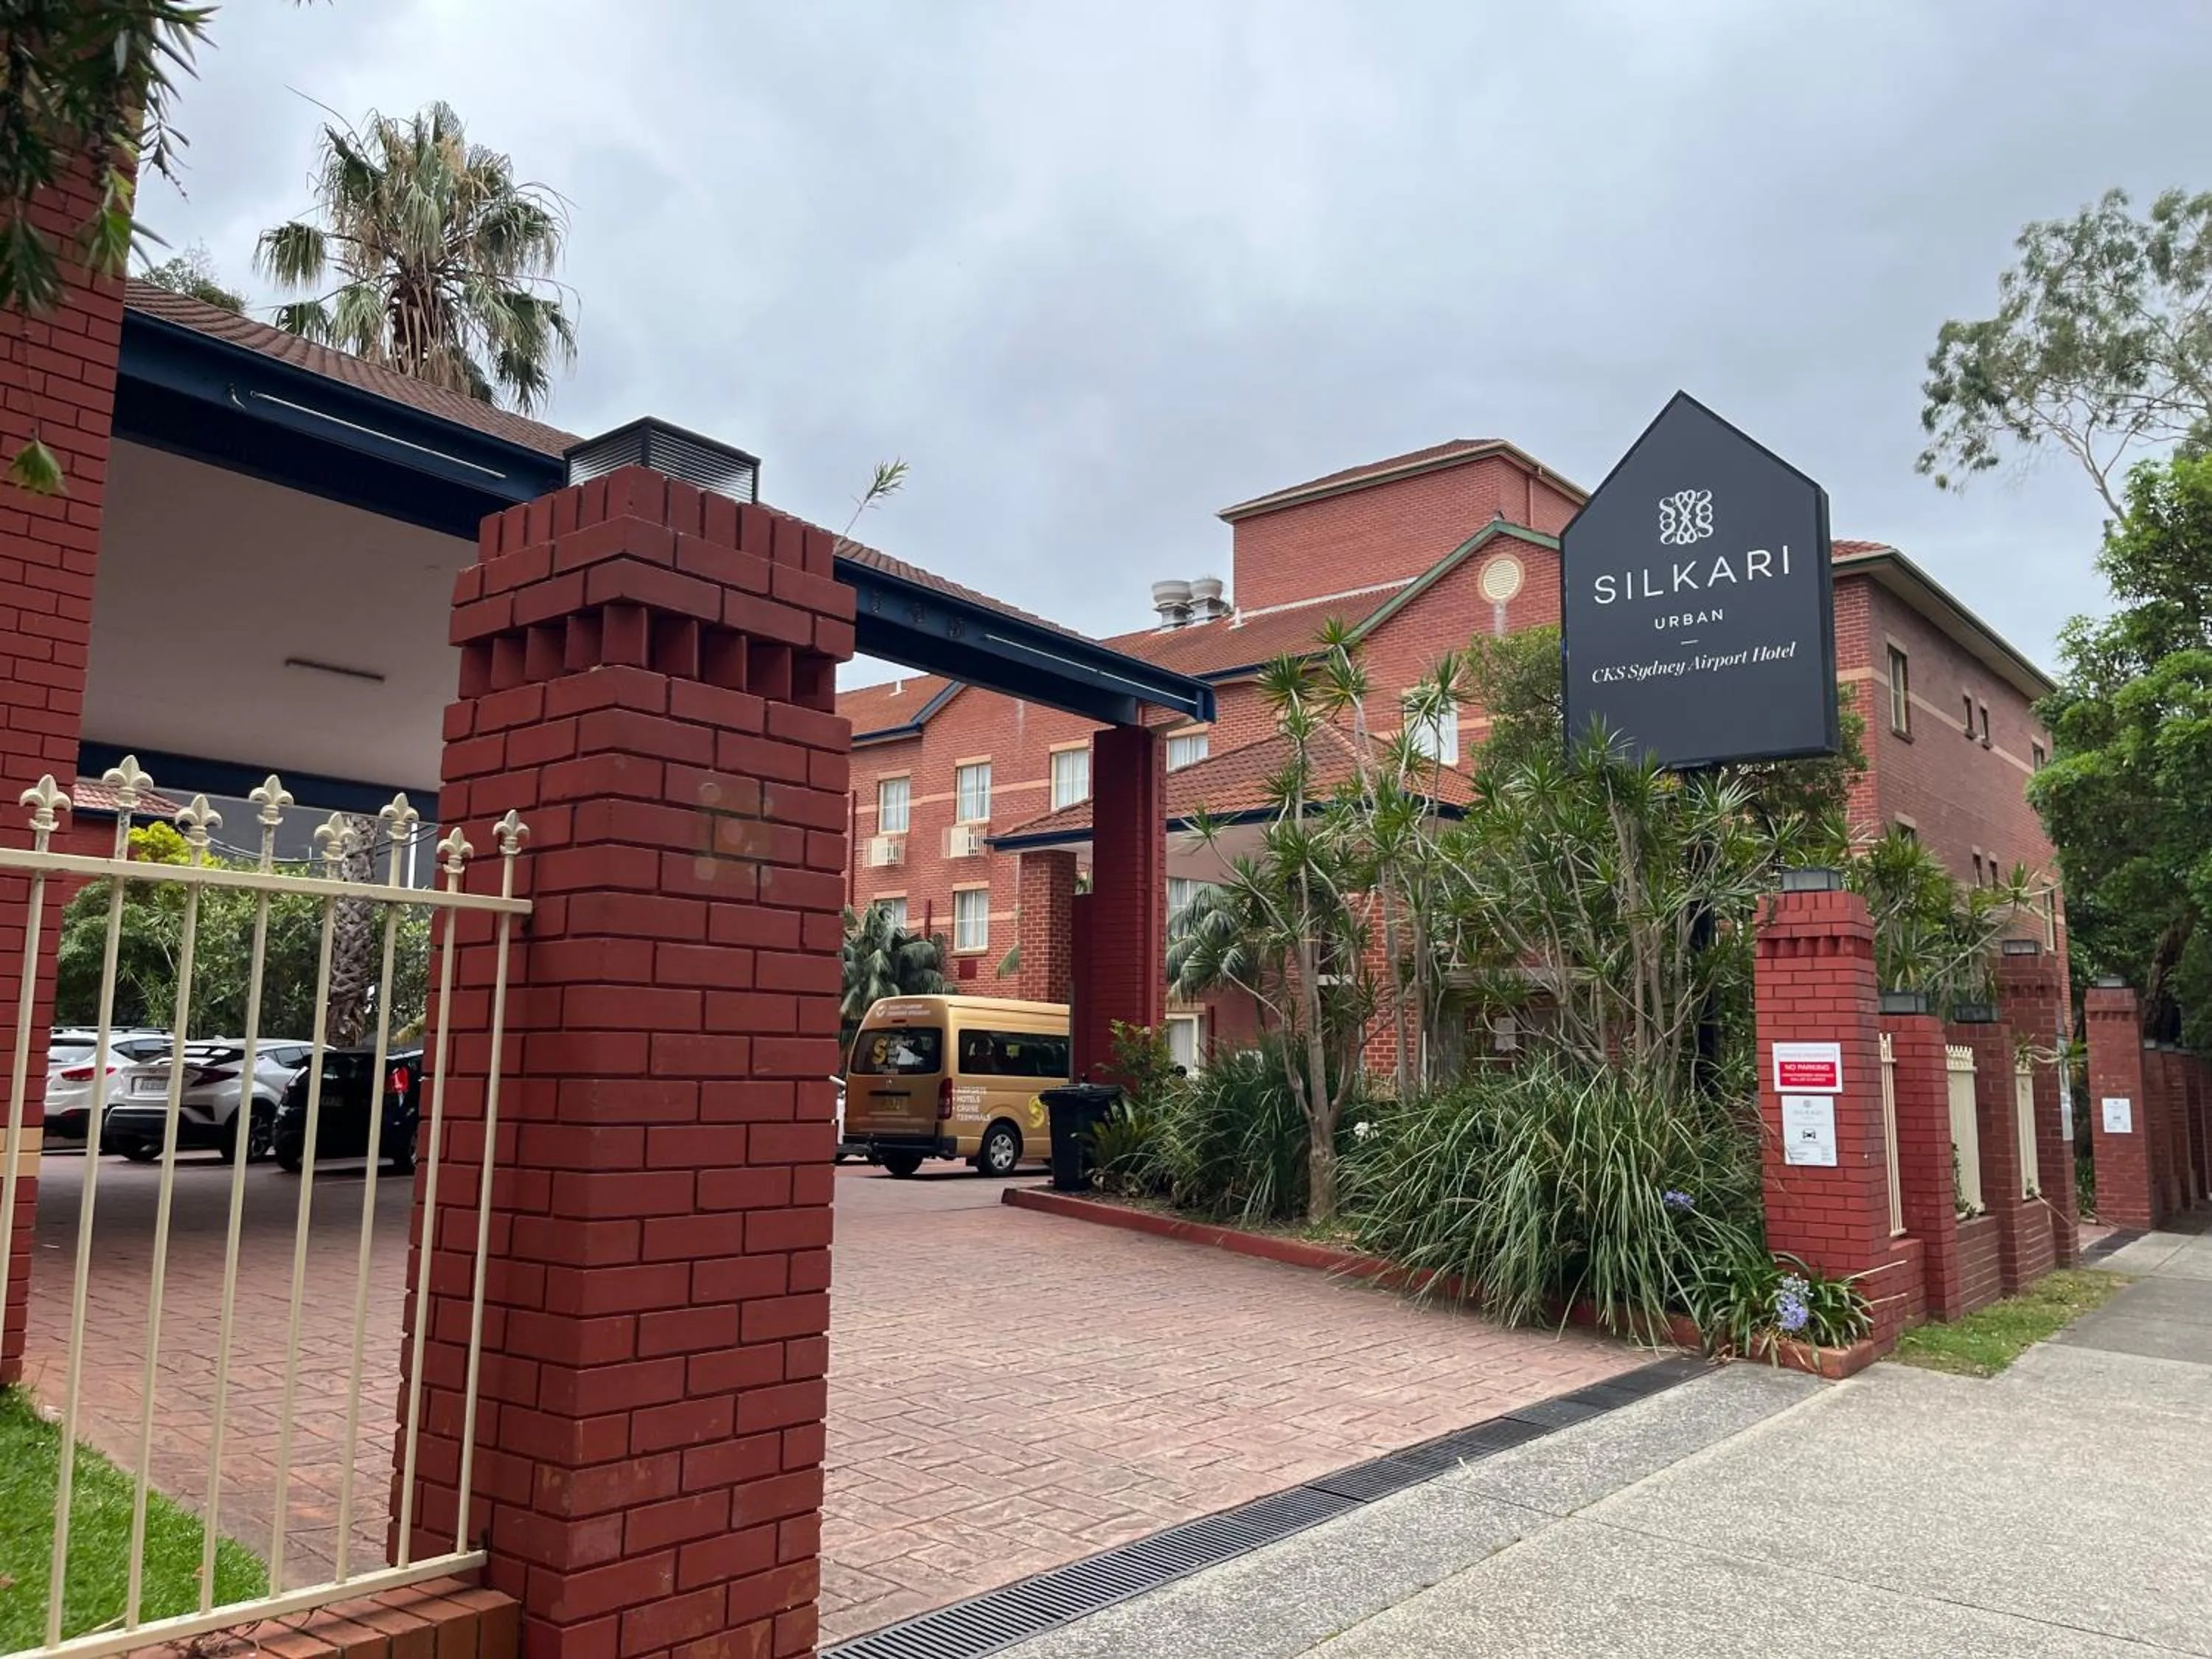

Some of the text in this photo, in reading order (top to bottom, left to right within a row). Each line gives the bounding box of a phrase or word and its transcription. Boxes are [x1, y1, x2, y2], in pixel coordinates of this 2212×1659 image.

[1593, 545, 1790, 605] SILKARI
[1654, 608, 1724, 630] URBAN
[1592, 640, 1797, 684] CKS Sydney Airport Hotel
